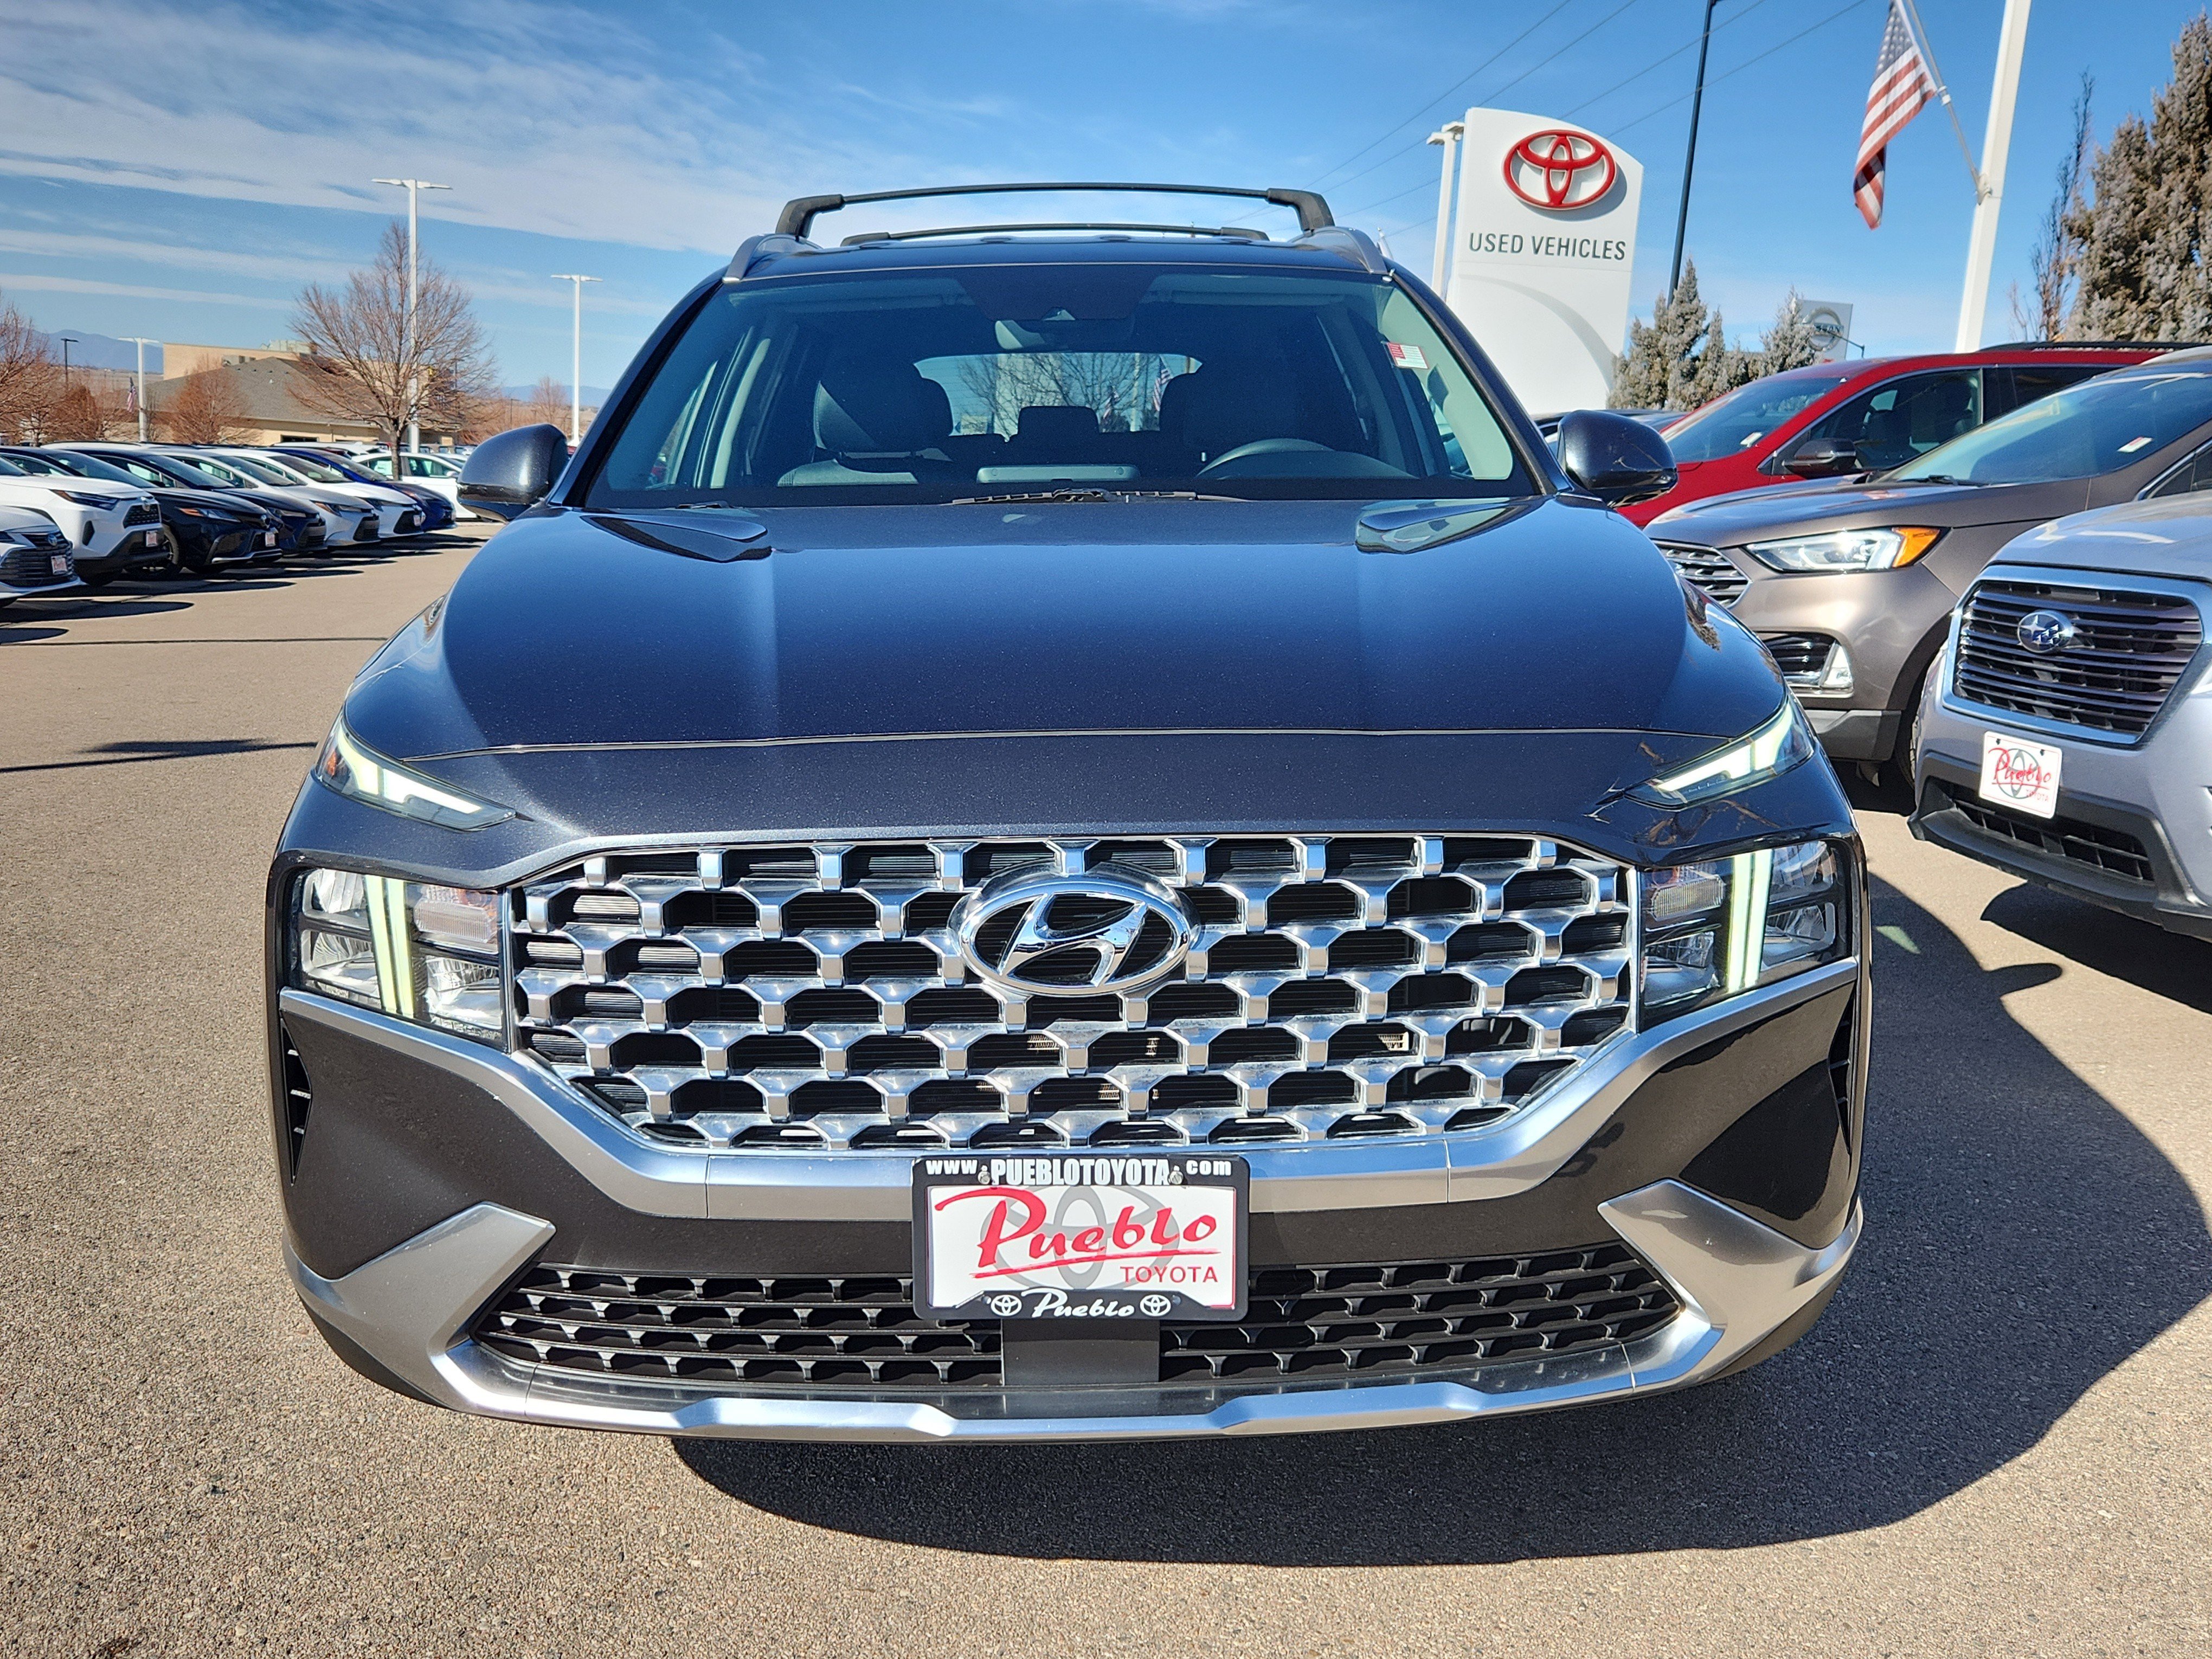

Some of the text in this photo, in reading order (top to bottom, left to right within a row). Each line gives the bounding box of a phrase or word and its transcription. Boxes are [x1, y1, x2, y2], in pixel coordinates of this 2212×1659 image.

[1470, 233, 1626, 260] USED VEHICLES
[1988, 748, 2052, 783] Pueblo
[935, 1186, 1218, 1267] Pueblo
[1120, 1265, 1218, 1283] TOYOTA
[1021, 1287, 1135, 1318] Pueblo
